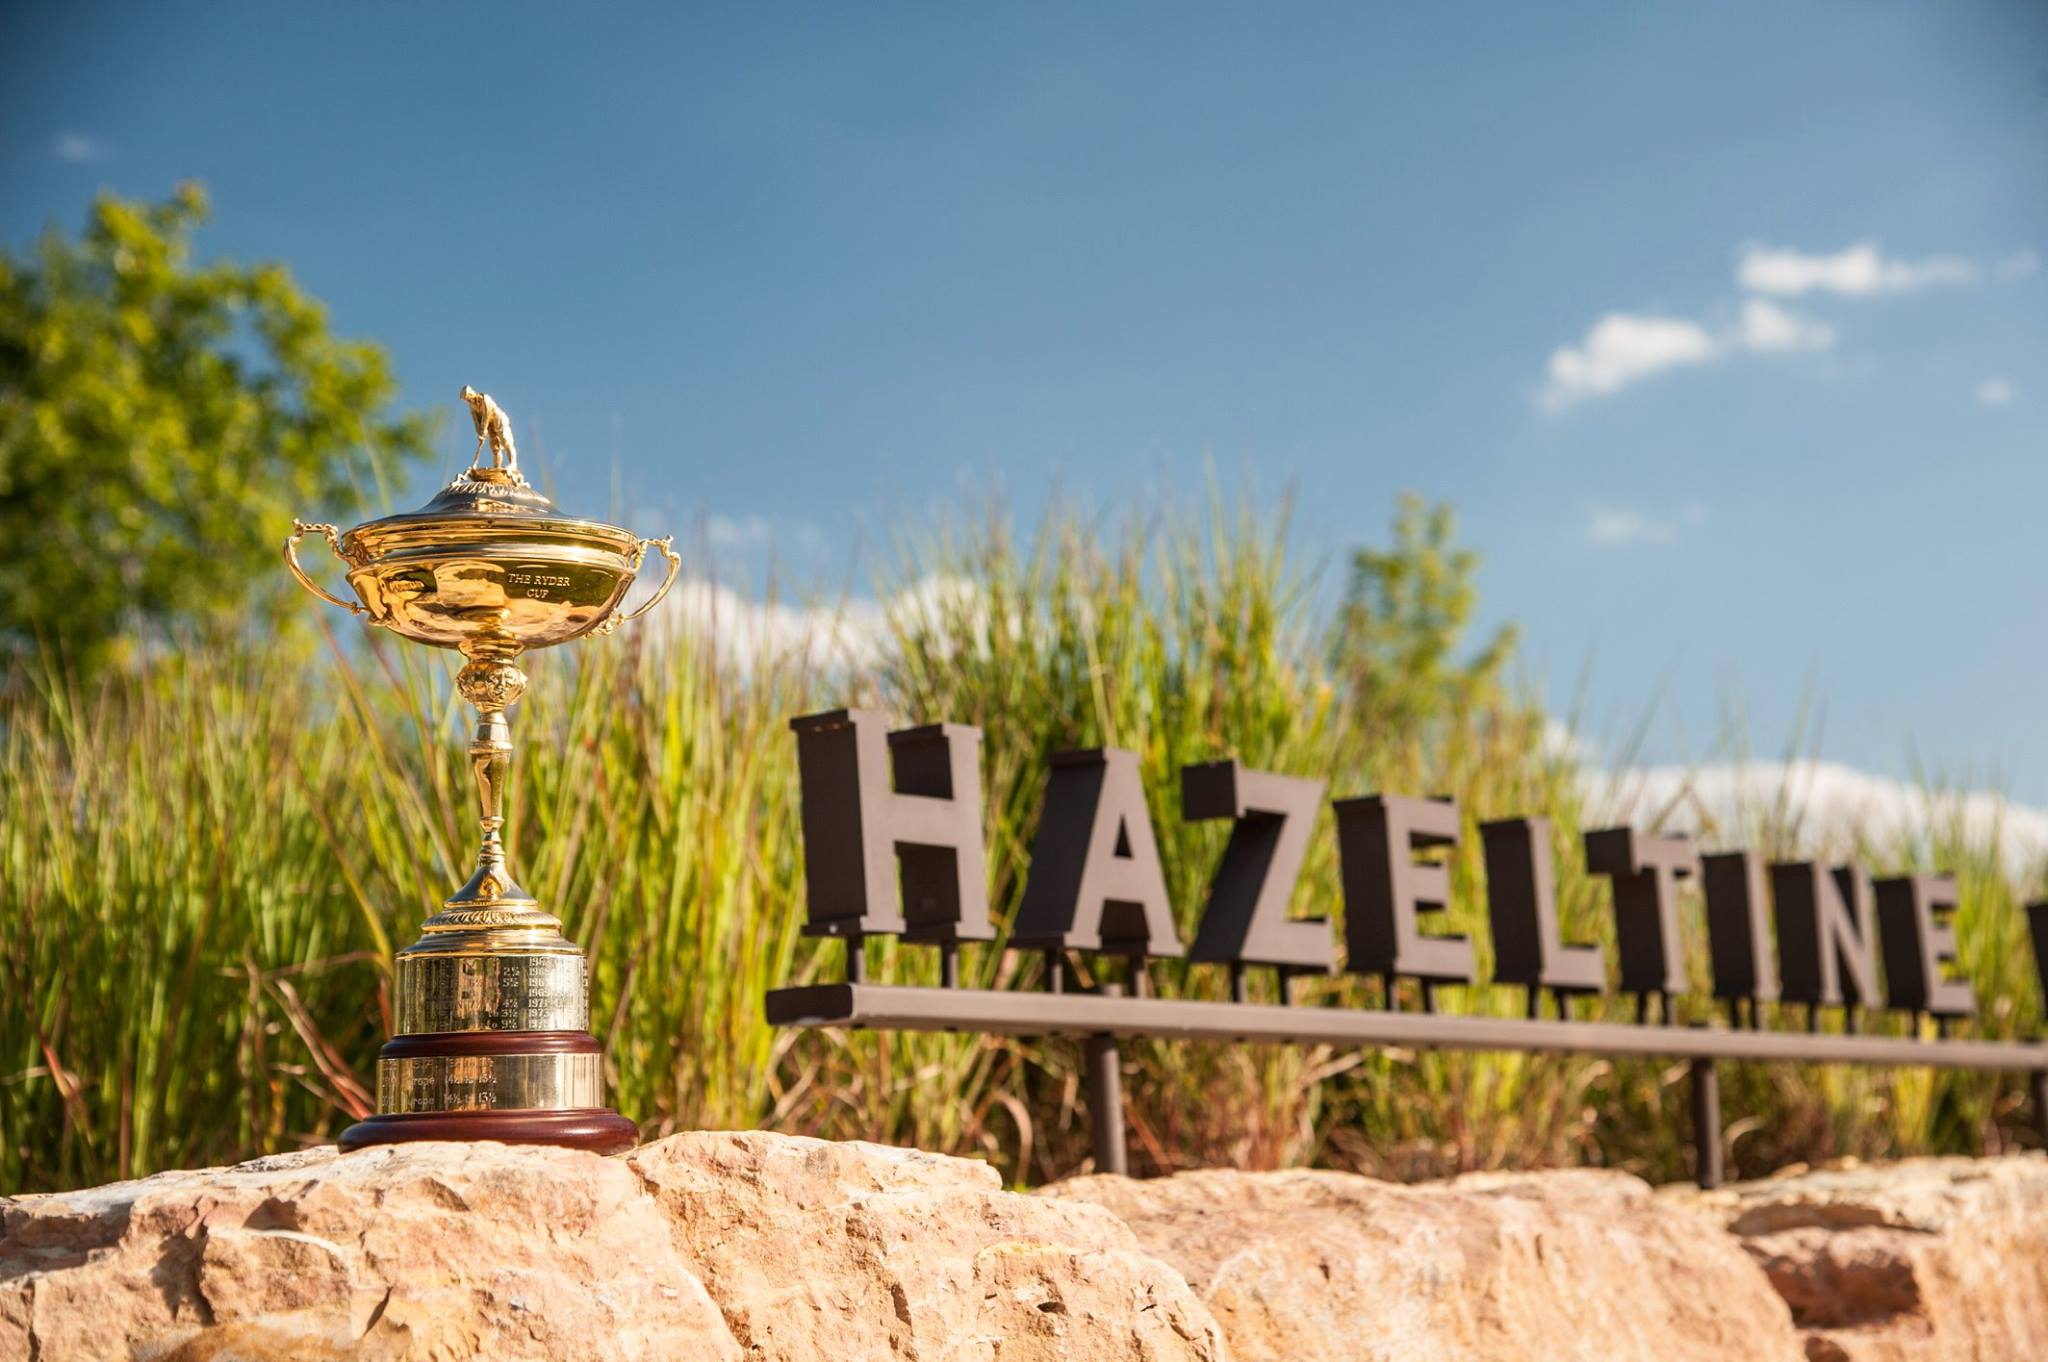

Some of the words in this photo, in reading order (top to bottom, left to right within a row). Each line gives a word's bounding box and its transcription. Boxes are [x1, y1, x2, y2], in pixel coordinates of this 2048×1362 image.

[508, 573, 531, 584] THE
[534, 575, 571, 586] RYDER
[526, 588, 550, 598] CUP
[791, 708, 1976, 1014] HAZELTINE
